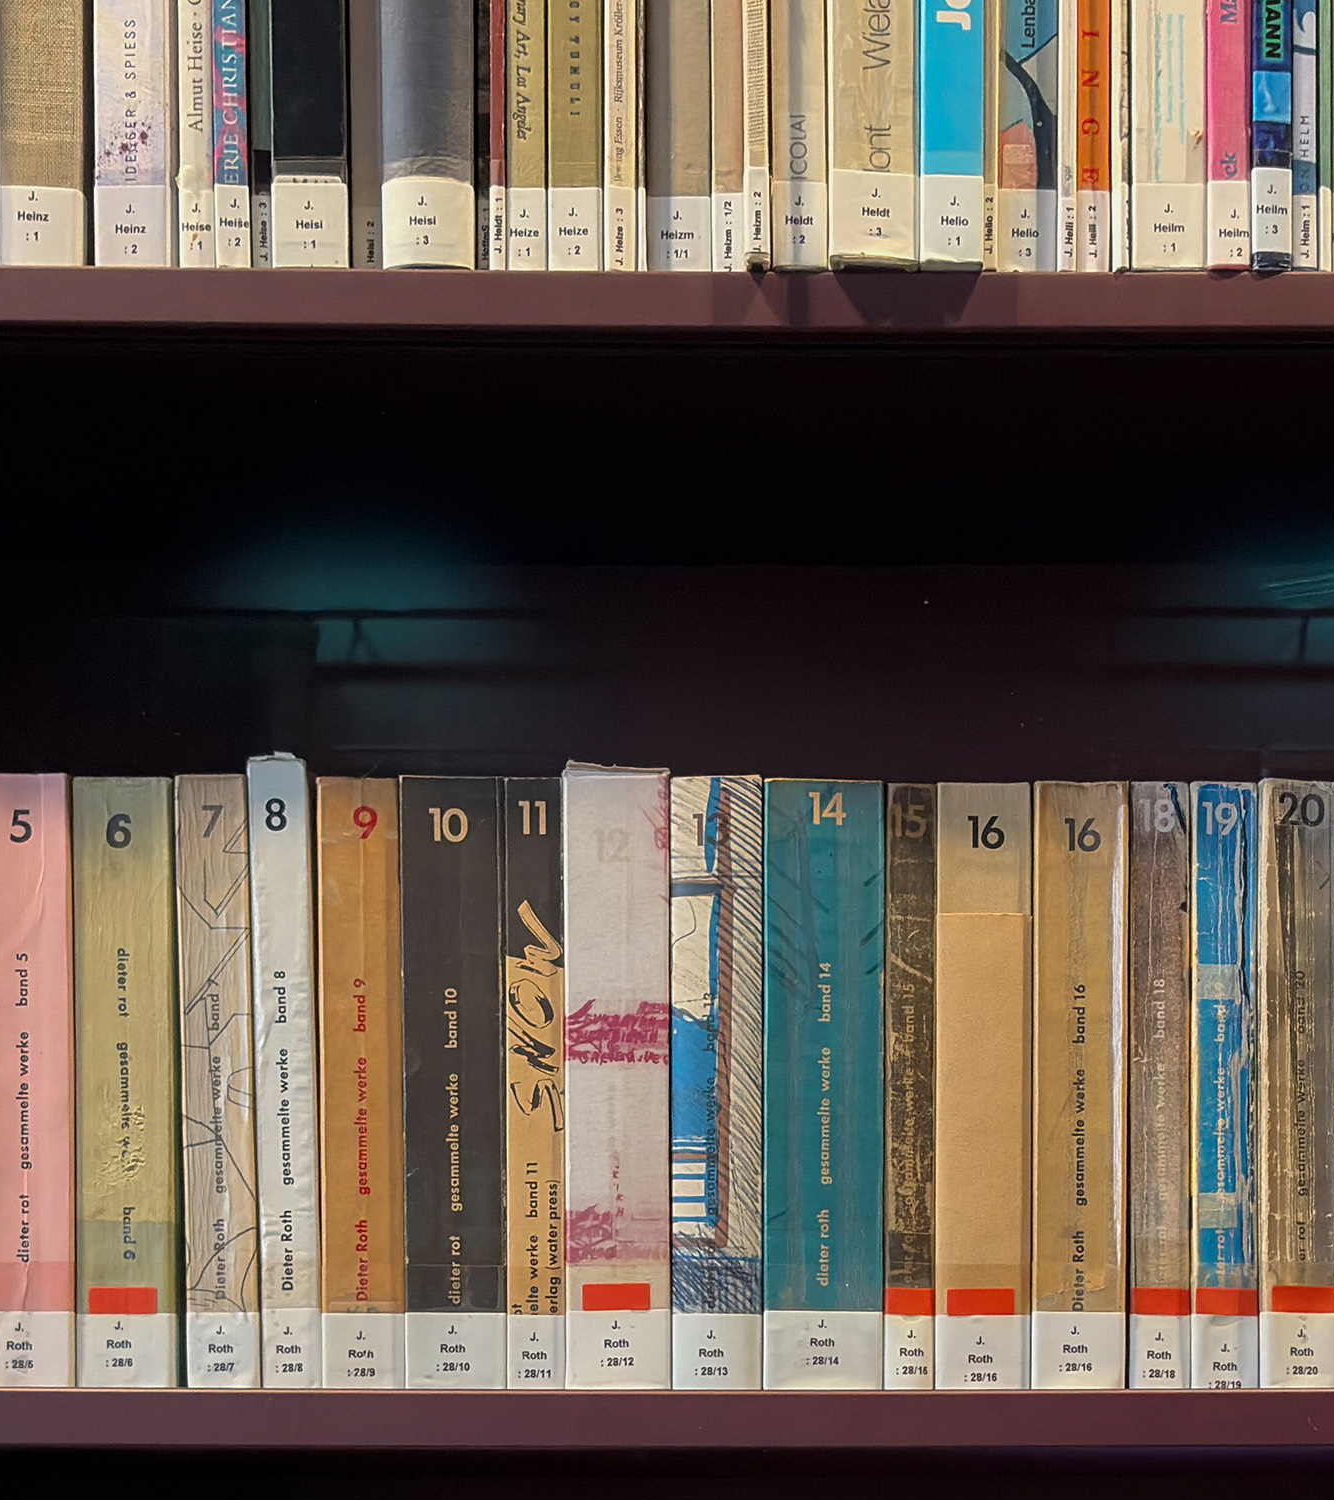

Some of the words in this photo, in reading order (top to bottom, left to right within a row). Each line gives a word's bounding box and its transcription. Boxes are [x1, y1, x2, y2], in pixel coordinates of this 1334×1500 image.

[17, 210, 49, 222] Heinz
[296, 219, 323, 230] Heisi
[862, 207, 890, 218] Heldt
[941, 216, 968, 228] Helio
[265, 798, 288, 832] 8
[354, 806, 378, 840] 9
[429, 807, 467, 843] 10
[808, 791, 847, 826] 14
[9, 810, 32, 844] 5
[105, 813, 132, 849] 6
[967, 815, 1005, 850] 16
[449, 1235, 461, 1257] rot
[448, 1261, 461, 1305] dieter
